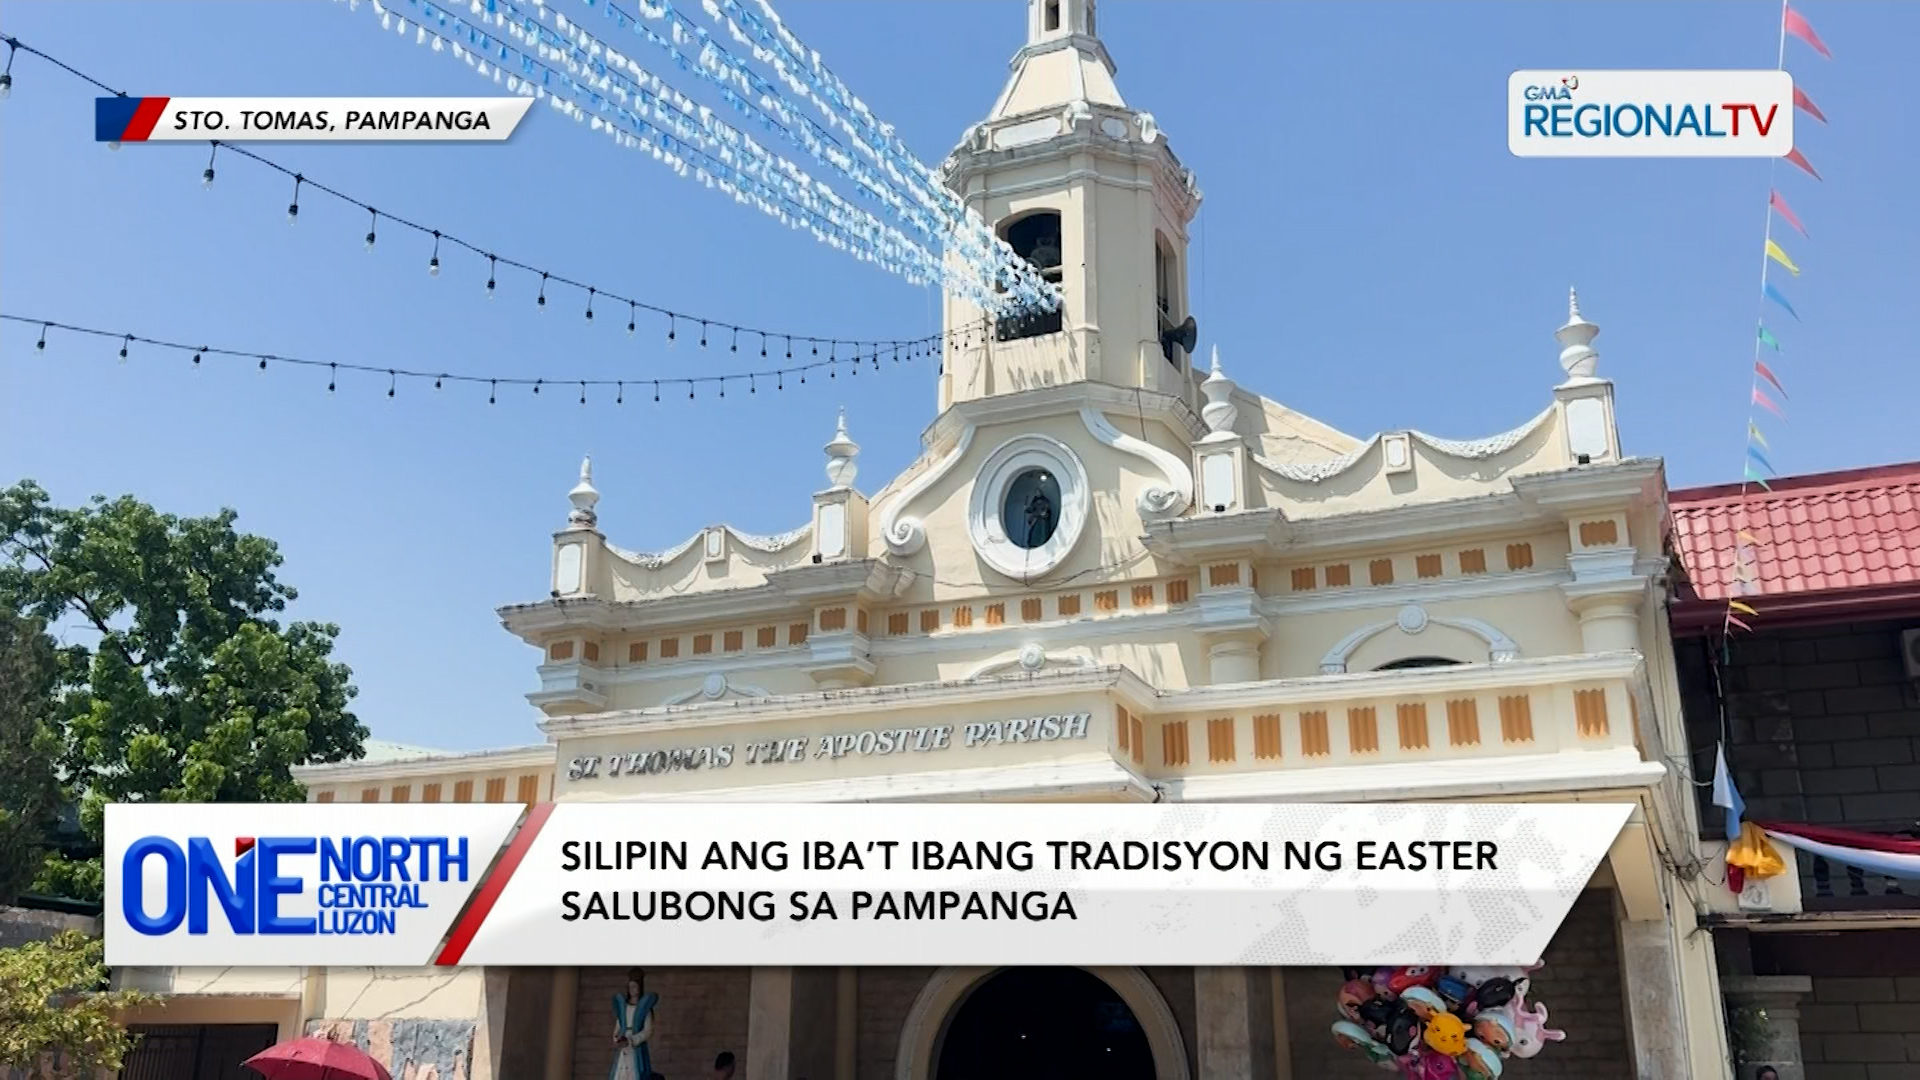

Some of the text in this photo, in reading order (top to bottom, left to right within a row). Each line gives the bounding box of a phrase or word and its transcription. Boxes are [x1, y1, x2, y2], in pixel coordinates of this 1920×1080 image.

[609, 744, 735, 778] THOMAS
[745, 737, 808, 766] THE
[814, 725, 954, 759] APOSTLE
[963, 712, 1091, 747] PARISH
